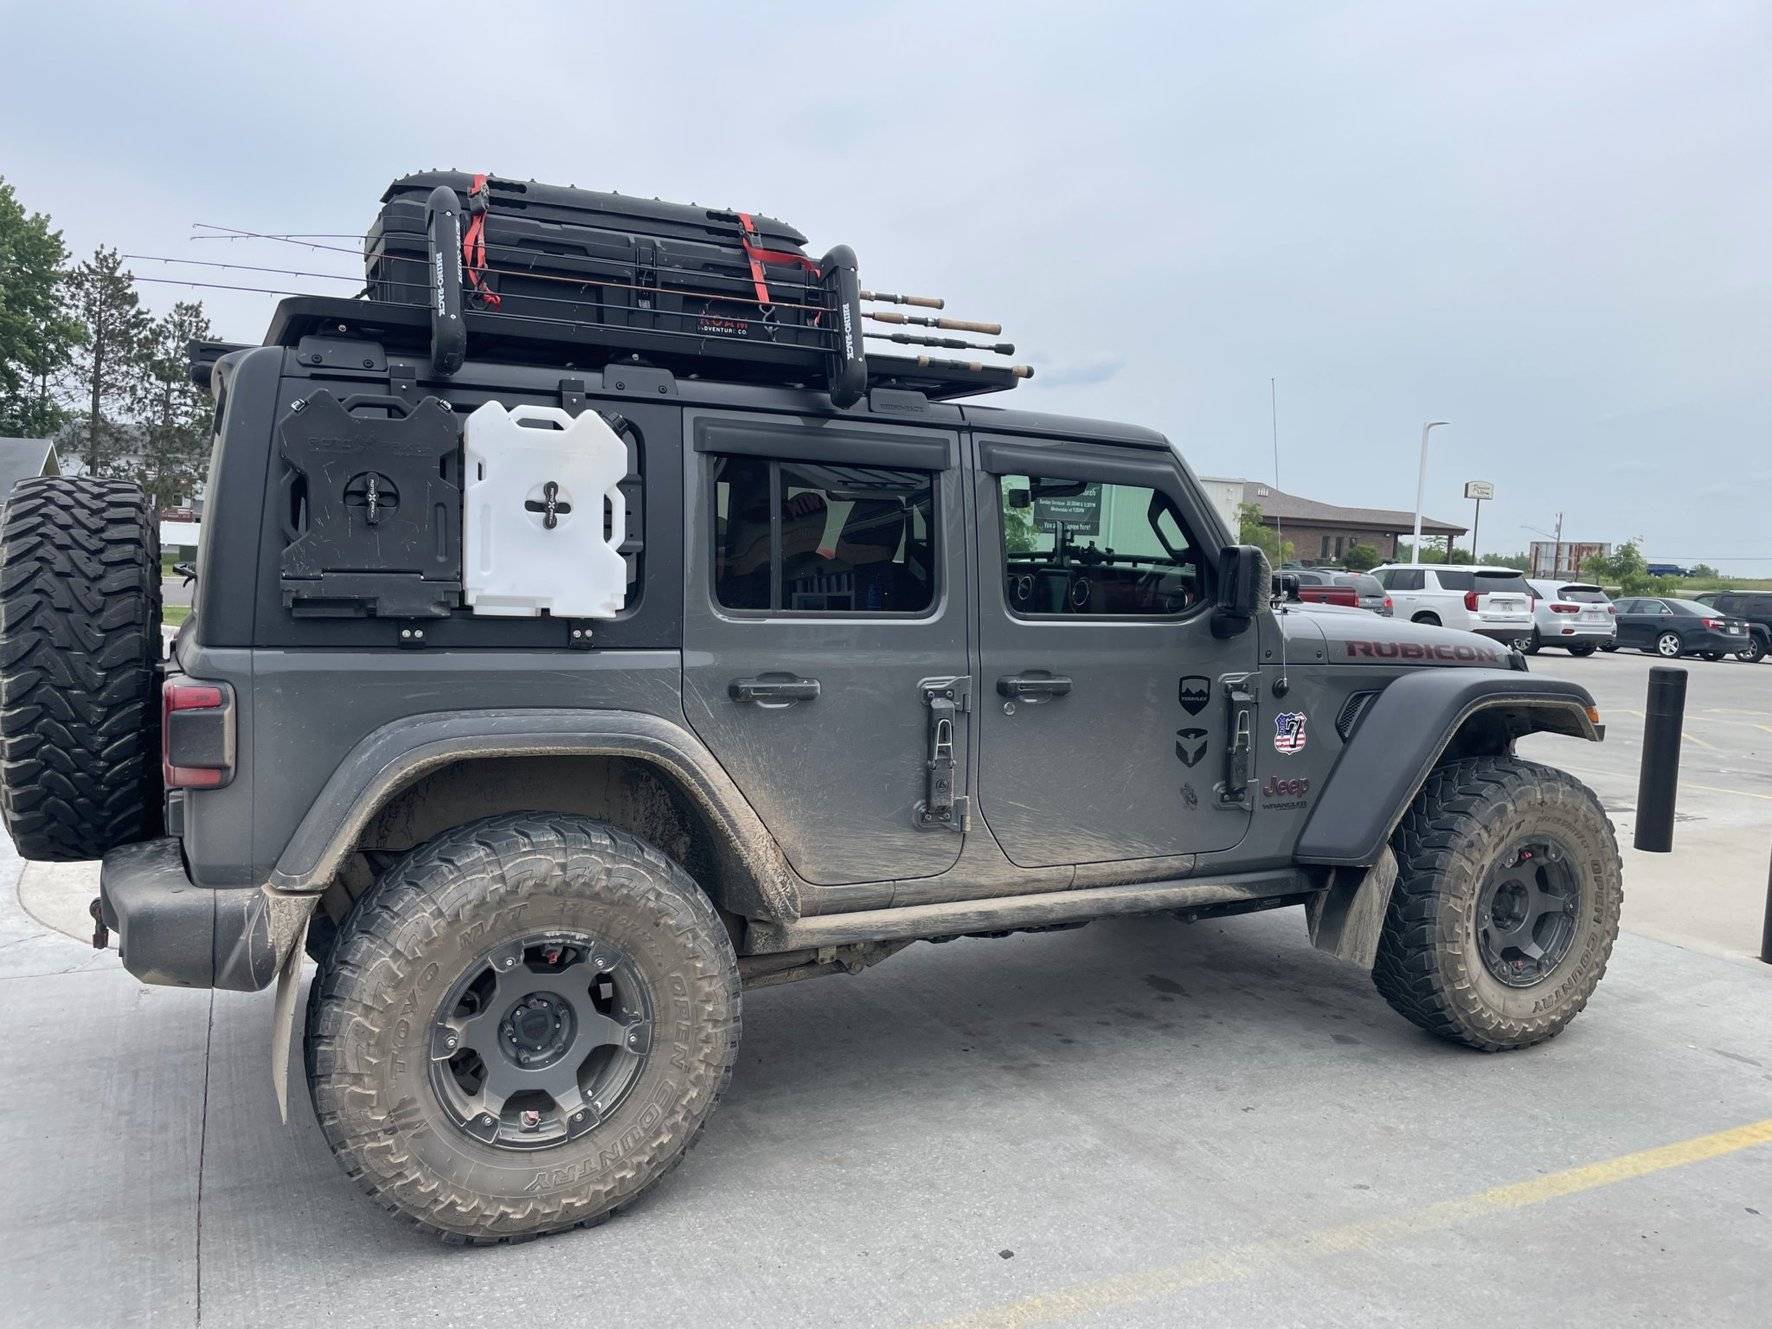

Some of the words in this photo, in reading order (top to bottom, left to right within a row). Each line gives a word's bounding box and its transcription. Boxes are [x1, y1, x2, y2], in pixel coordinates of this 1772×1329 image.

[436, 252, 446, 317] RHINO-RACK
[842, 302, 855, 361] RHINO-RACK
[1344, 640, 1497, 662] RUBICON
[1285, 718, 1301, 749] 7
[1263, 775, 1309, 798] Jeep
[1590, 859, 1604, 925] OPEN
[1532, 930, 1599, 1015] COUNTRY
[390, 962, 440, 1081] TOYO
[670, 973, 692, 1075] OPEN
[523, 1078, 680, 1192] COUNTRY
